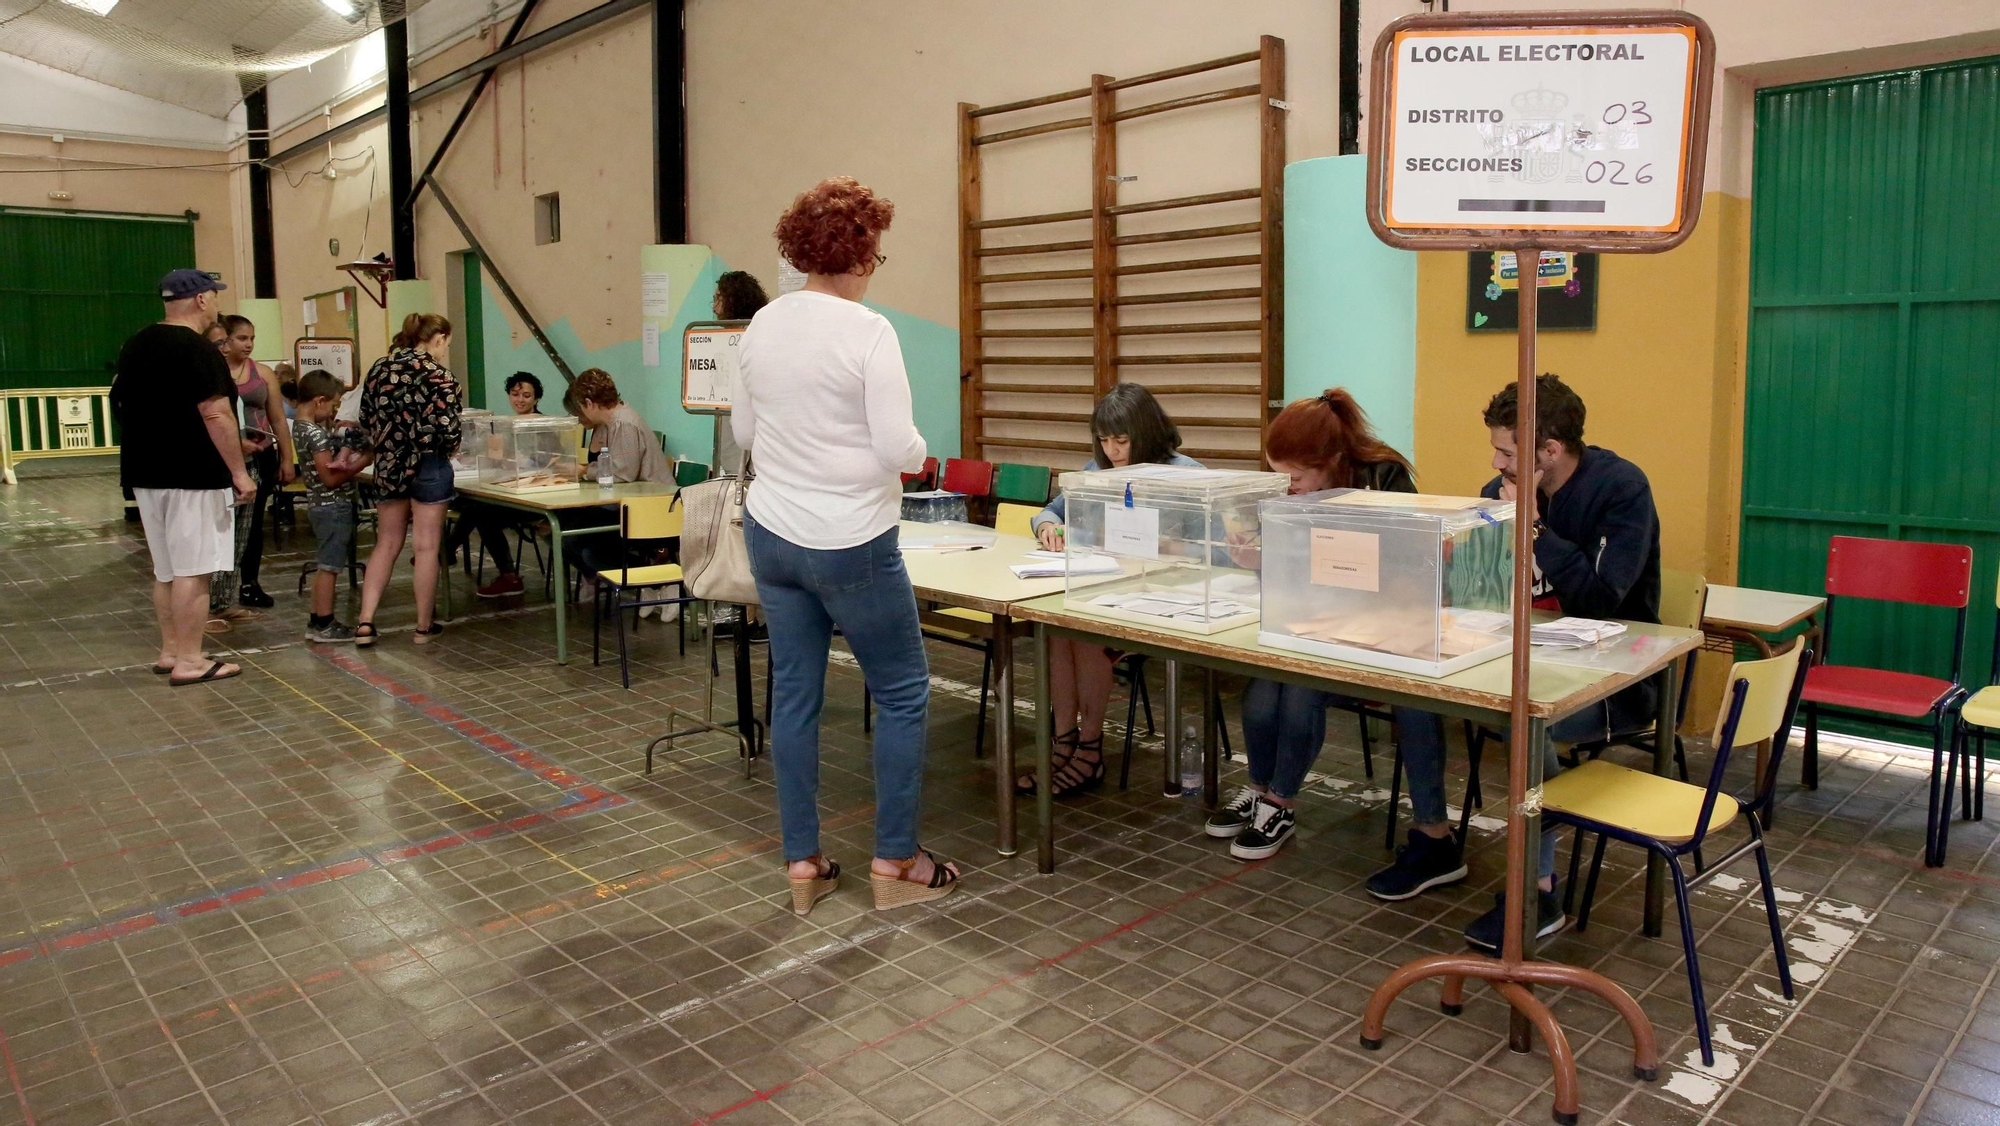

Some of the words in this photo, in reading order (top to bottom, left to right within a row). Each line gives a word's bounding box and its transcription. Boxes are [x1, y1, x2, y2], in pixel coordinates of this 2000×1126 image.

[1411, 45, 1490, 63] LOCAL
[1498, 44, 1645, 62] ELECTORAL
[1408, 109, 1504, 124] DISTRITO
[1602, 101, 1653, 125] 03
[1405, 157, 1523, 173] SECCIONES
[1585, 160, 1653, 185] 026
[690, 358, 716, 370] MESA
[708, 385, 715, 401] A
